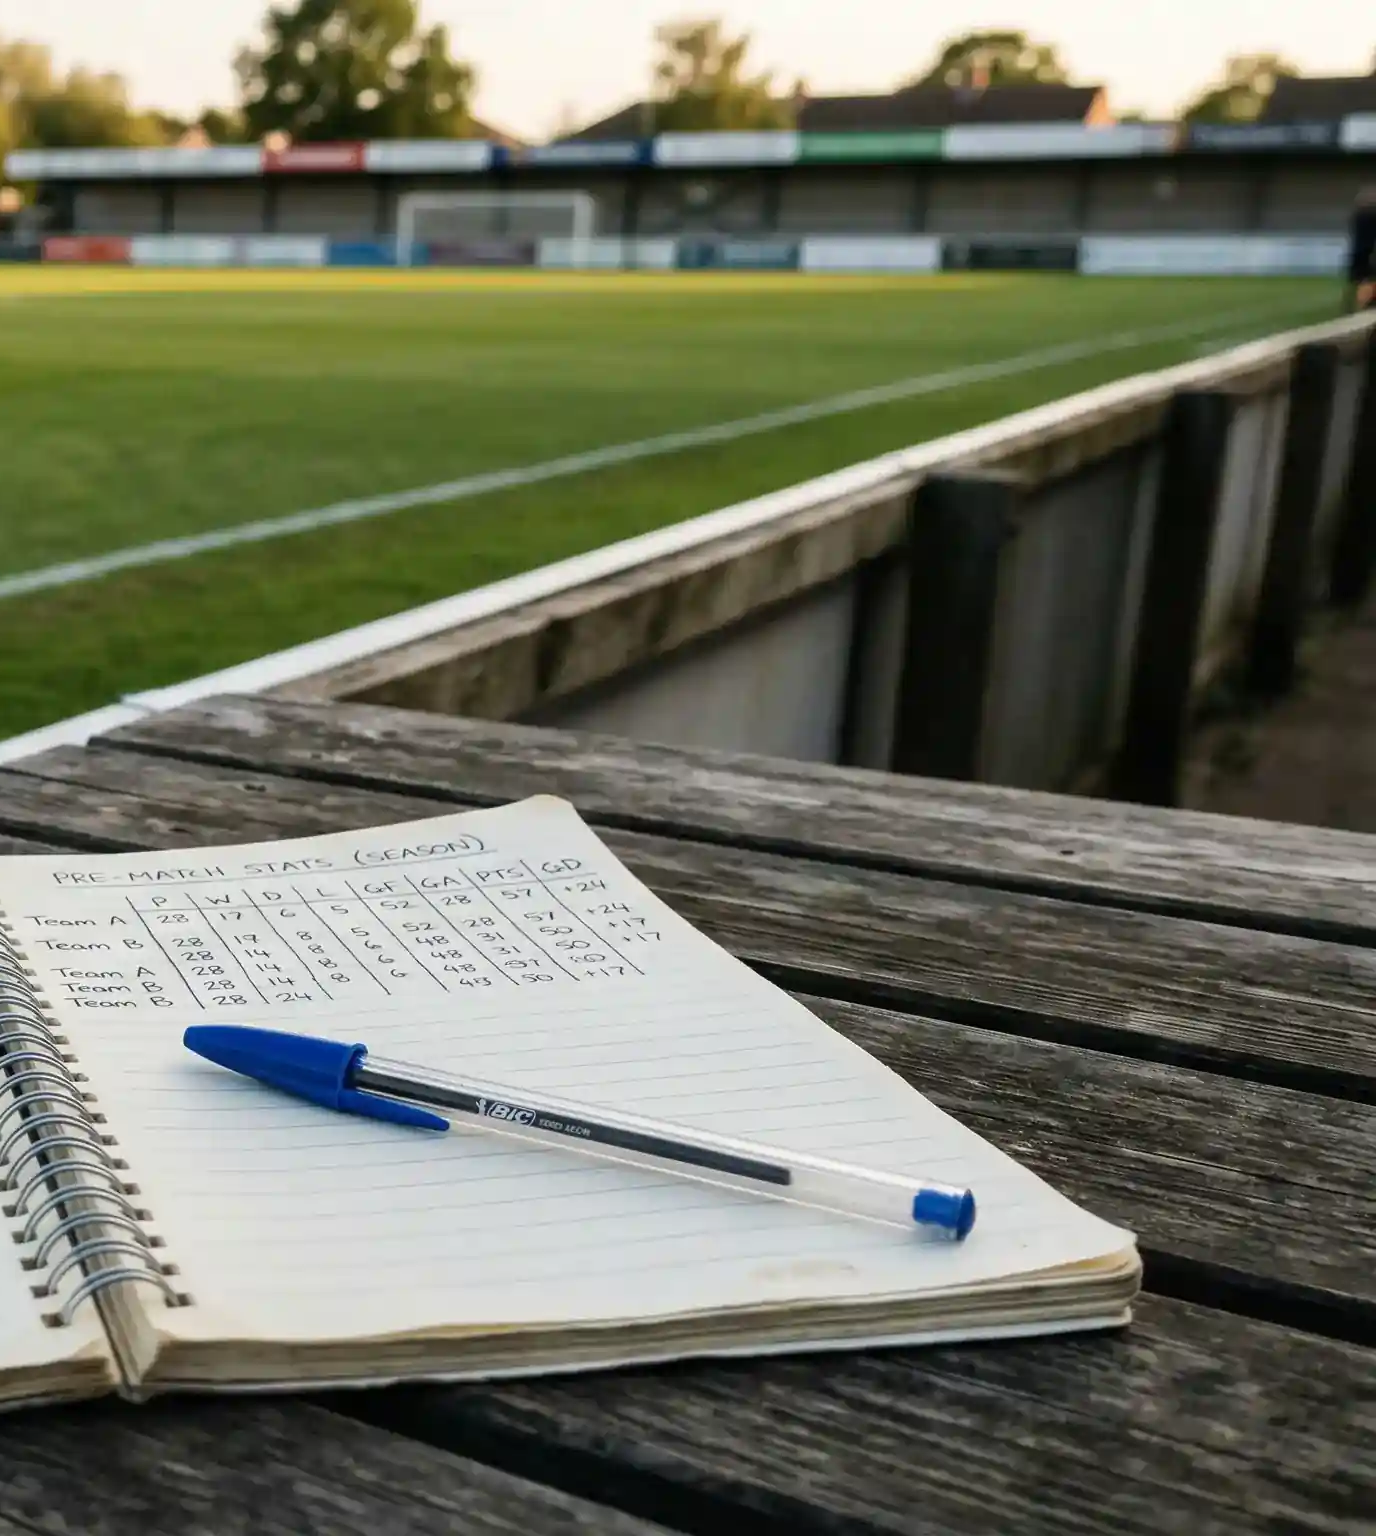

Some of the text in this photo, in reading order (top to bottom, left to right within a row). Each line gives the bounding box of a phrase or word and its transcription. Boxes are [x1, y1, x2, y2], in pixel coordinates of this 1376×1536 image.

[52, 836, 485, 885] PRE-MATCH STATS (SEASON)
[151, 859, 582, 906] P W D L GF GA PTS GD
[24, 879, 607, 927] Team A 28 17 6 5 52 28 57 +24
[36, 939, 111, 951] Team
[123, 939, 144, 950] B
[172, 937, 204, 948] 28
[296, 930, 313, 941] 8
[350, 926, 370, 937] 5
[402, 921, 434, 933] 52
[462, 916, 495, 928] 28
[523, 910, 555, 922] 57
[587, 903, 633, 916] +24
[181, 917, 647, 962] 28 14 8 6 48 31 50 +17
[50, 967, 124, 979] Team
[136, 966, 155, 978] A
[191, 965, 225, 976] 28
[255, 962, 283, 973] 14
[377, 954, 396, 965] 6
[430, 949, 464, 960] 48
[491, 944, 522, 955] 31
[555, 940, 591, 950] 50
[622, 931, 662, 943] +17
[60, 982, 131, 993] Team
[142, 982, 163, 993] B
[203, 979, 236, 991] 28
[268, 976, 296, 987] 14
[330, 972, 351, 984] 8
[390, 968, 409, 979] 6
[64, 997, 137, 1009] Team
[150, 997, 174, 1008] B
[213, 995, 248, 1006] 28
[275, 991, 313, 1003] 24
[522, 972, 554, 984] 50
[584, 966, 625, 978] +17
[491, 1104, 533, 1125] BIC
